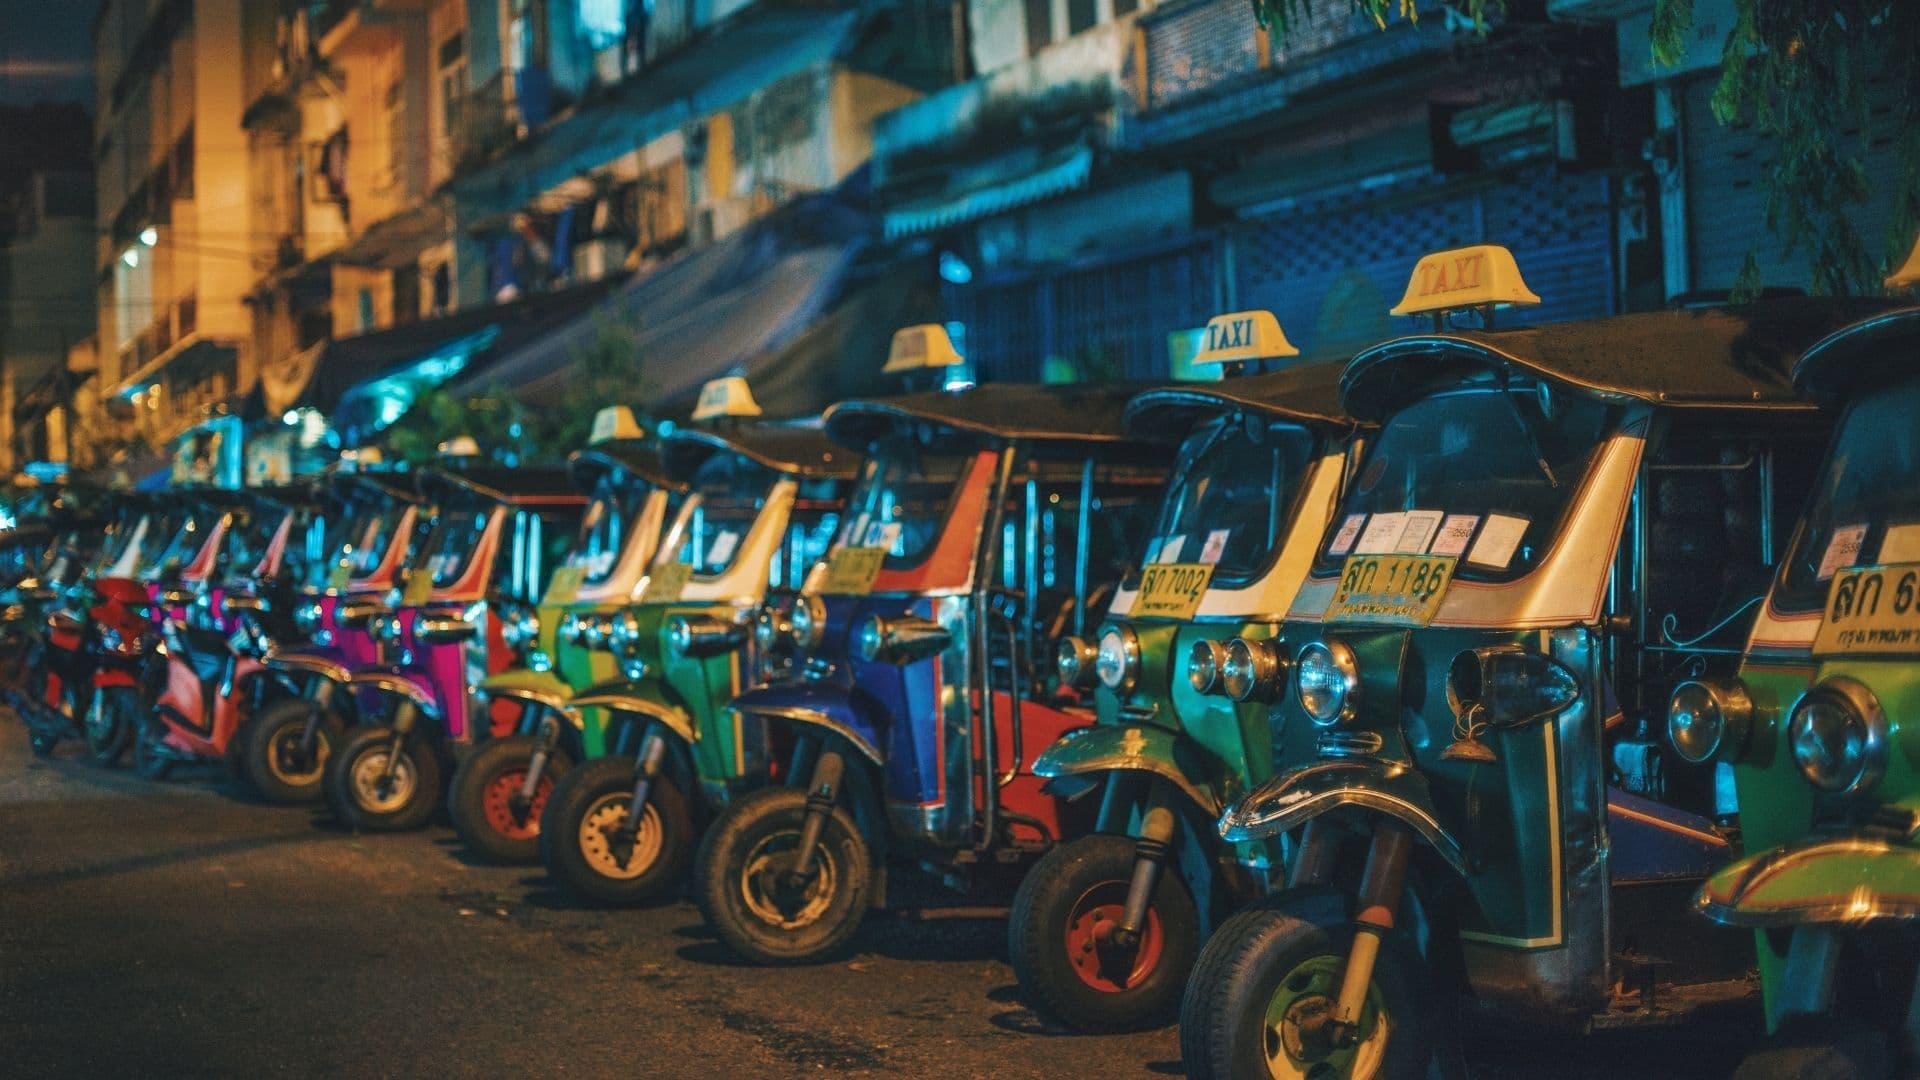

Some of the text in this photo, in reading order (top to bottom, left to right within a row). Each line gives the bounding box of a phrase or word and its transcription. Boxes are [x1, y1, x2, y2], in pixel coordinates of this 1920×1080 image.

[1419, 252, 1484, 297] TAXI
[1208, 318, 1253, 352] TAXI
[1166, 567, 1206, 597] 7002
[1386, 559, 1447, 597] 1186
[1893, 571, 1920, 615] 6
